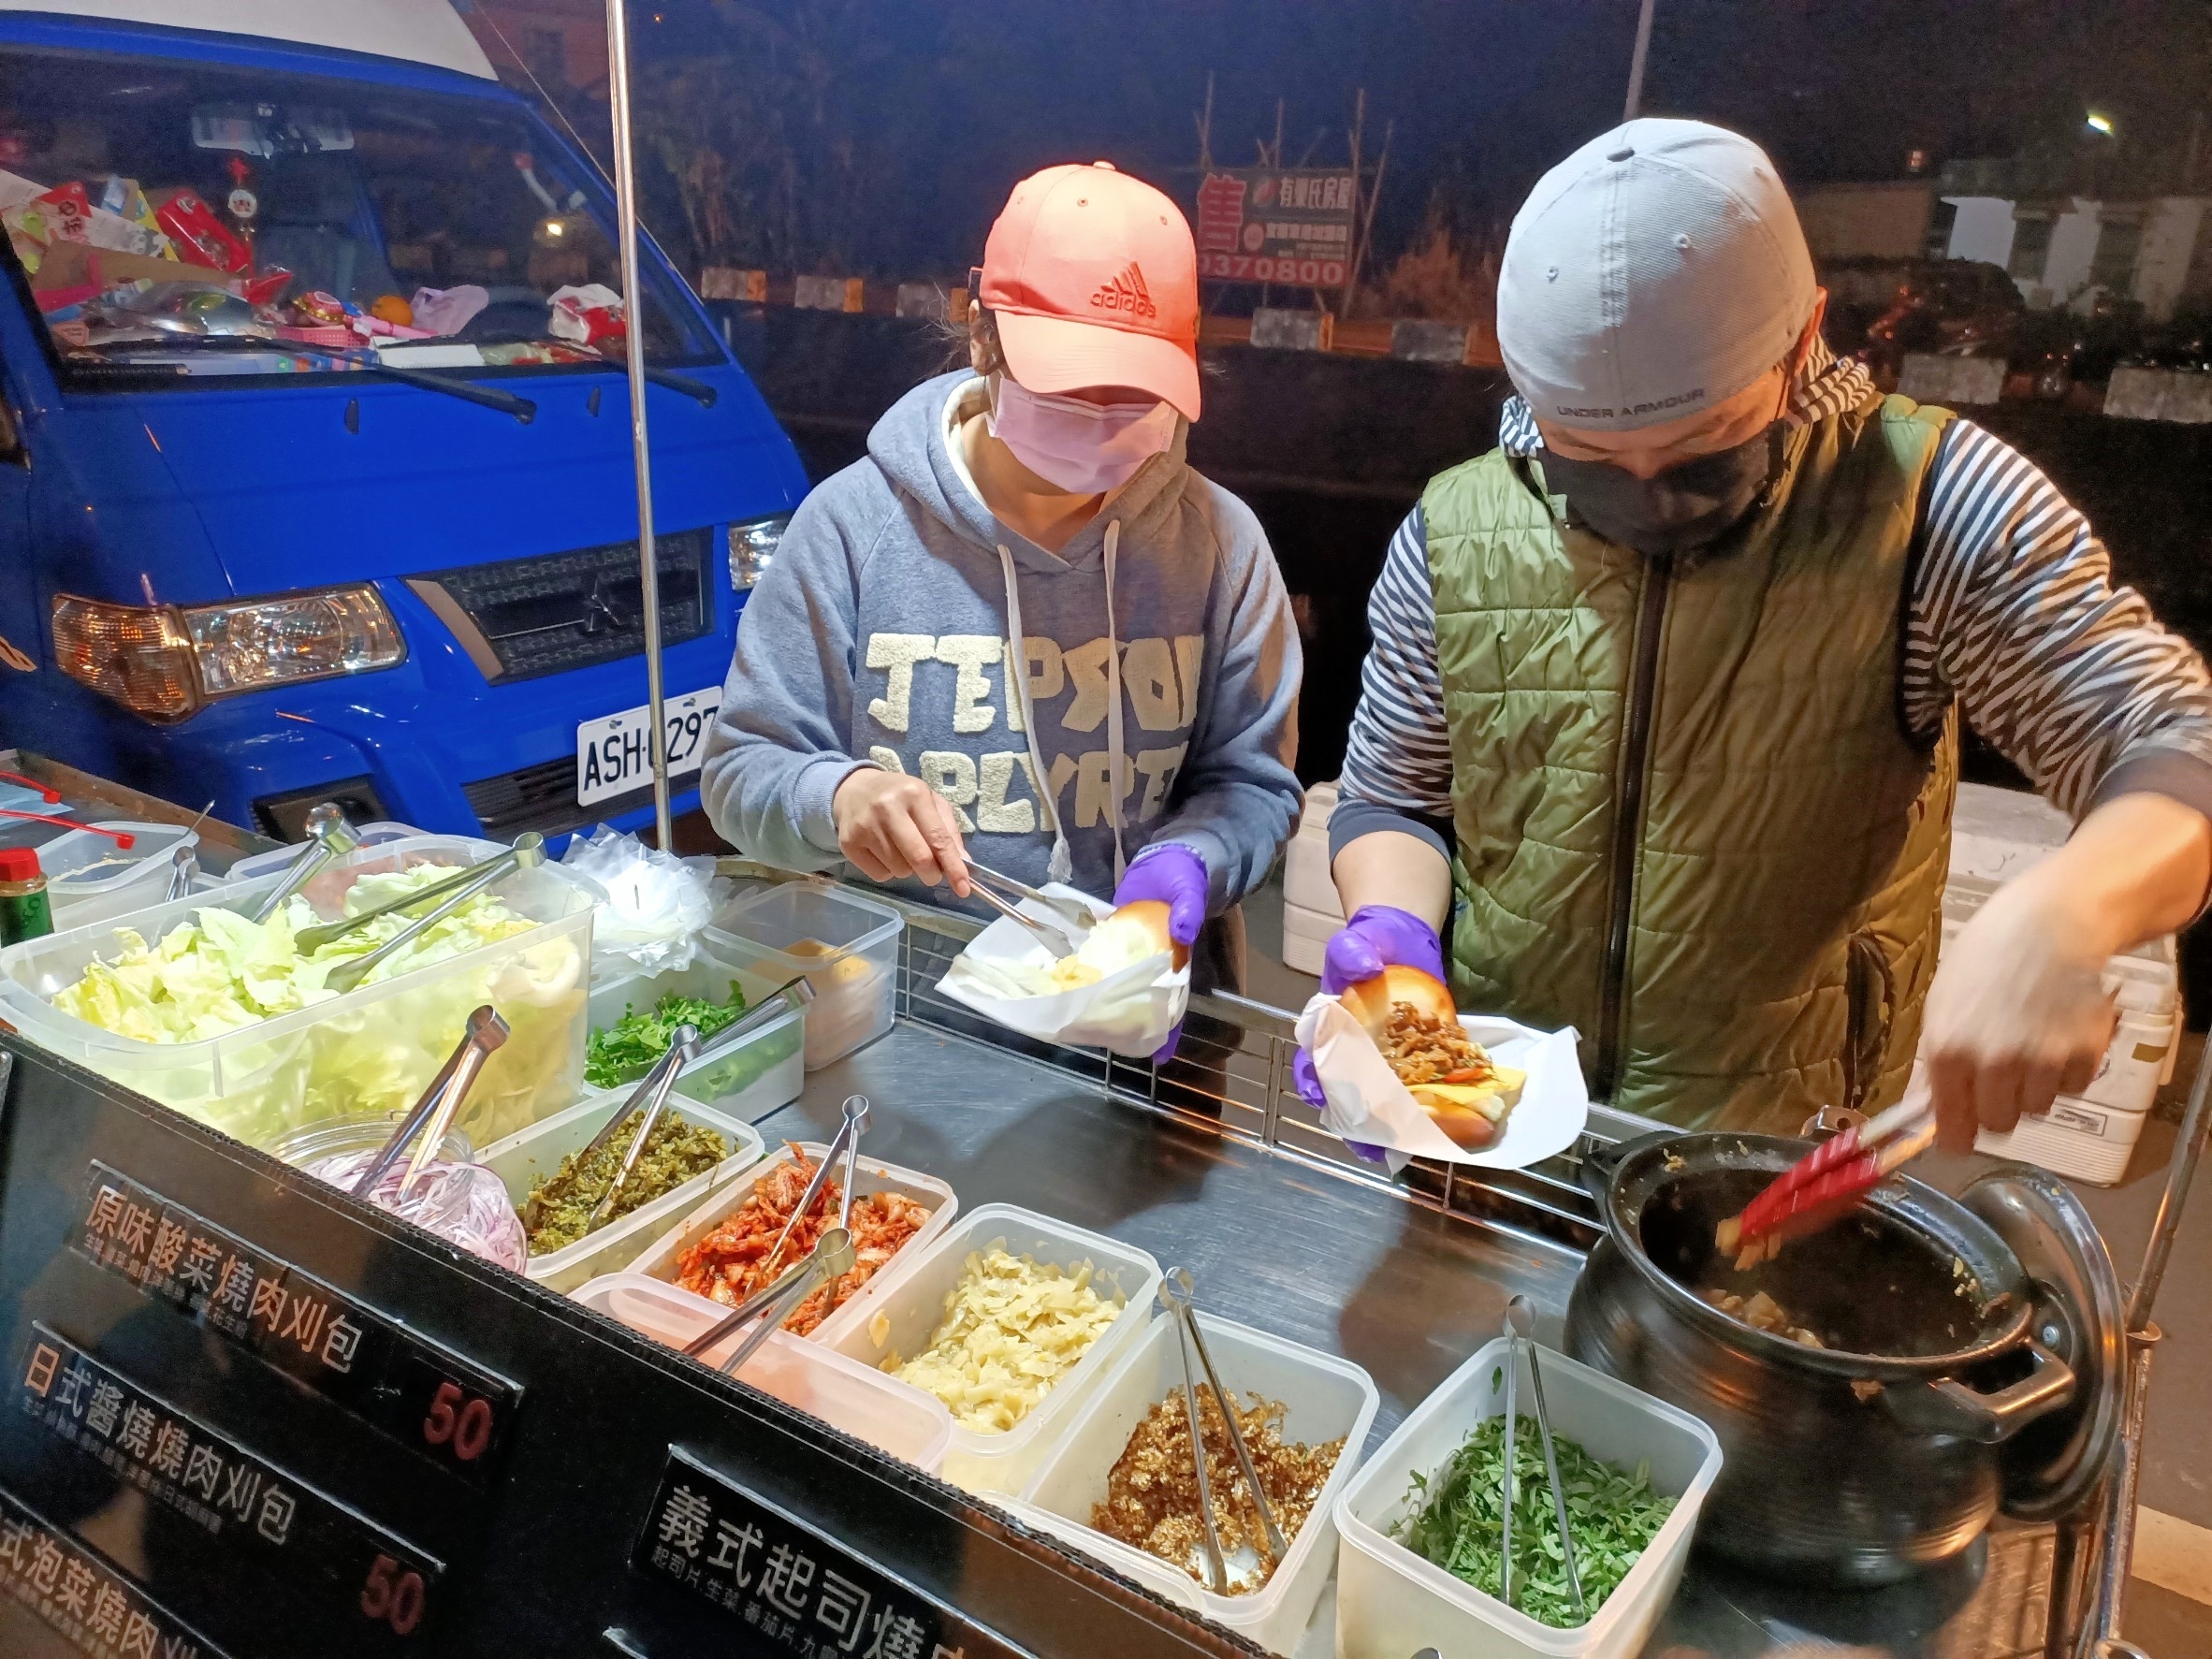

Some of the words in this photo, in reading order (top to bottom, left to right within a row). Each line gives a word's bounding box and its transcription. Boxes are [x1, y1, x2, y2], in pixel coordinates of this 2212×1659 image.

[1089, 291, 1157, 319] adidas
[1556, 405, 1614, 418] UNDER
[1621, 388, 1706, 416] ARMOUR
[583, 705, 720, 792] ASH-297
[85, 1184, 362, 1375] 原味酸菜燒肉刈包
[24, 1342, 297, 1545] 日式醬燒燒肉刈包
[424, 1381, 493, 1461] 50
[361, 1553, 425, 1636] 50
[659, 1484, 965, 1659] 義式起司燒
